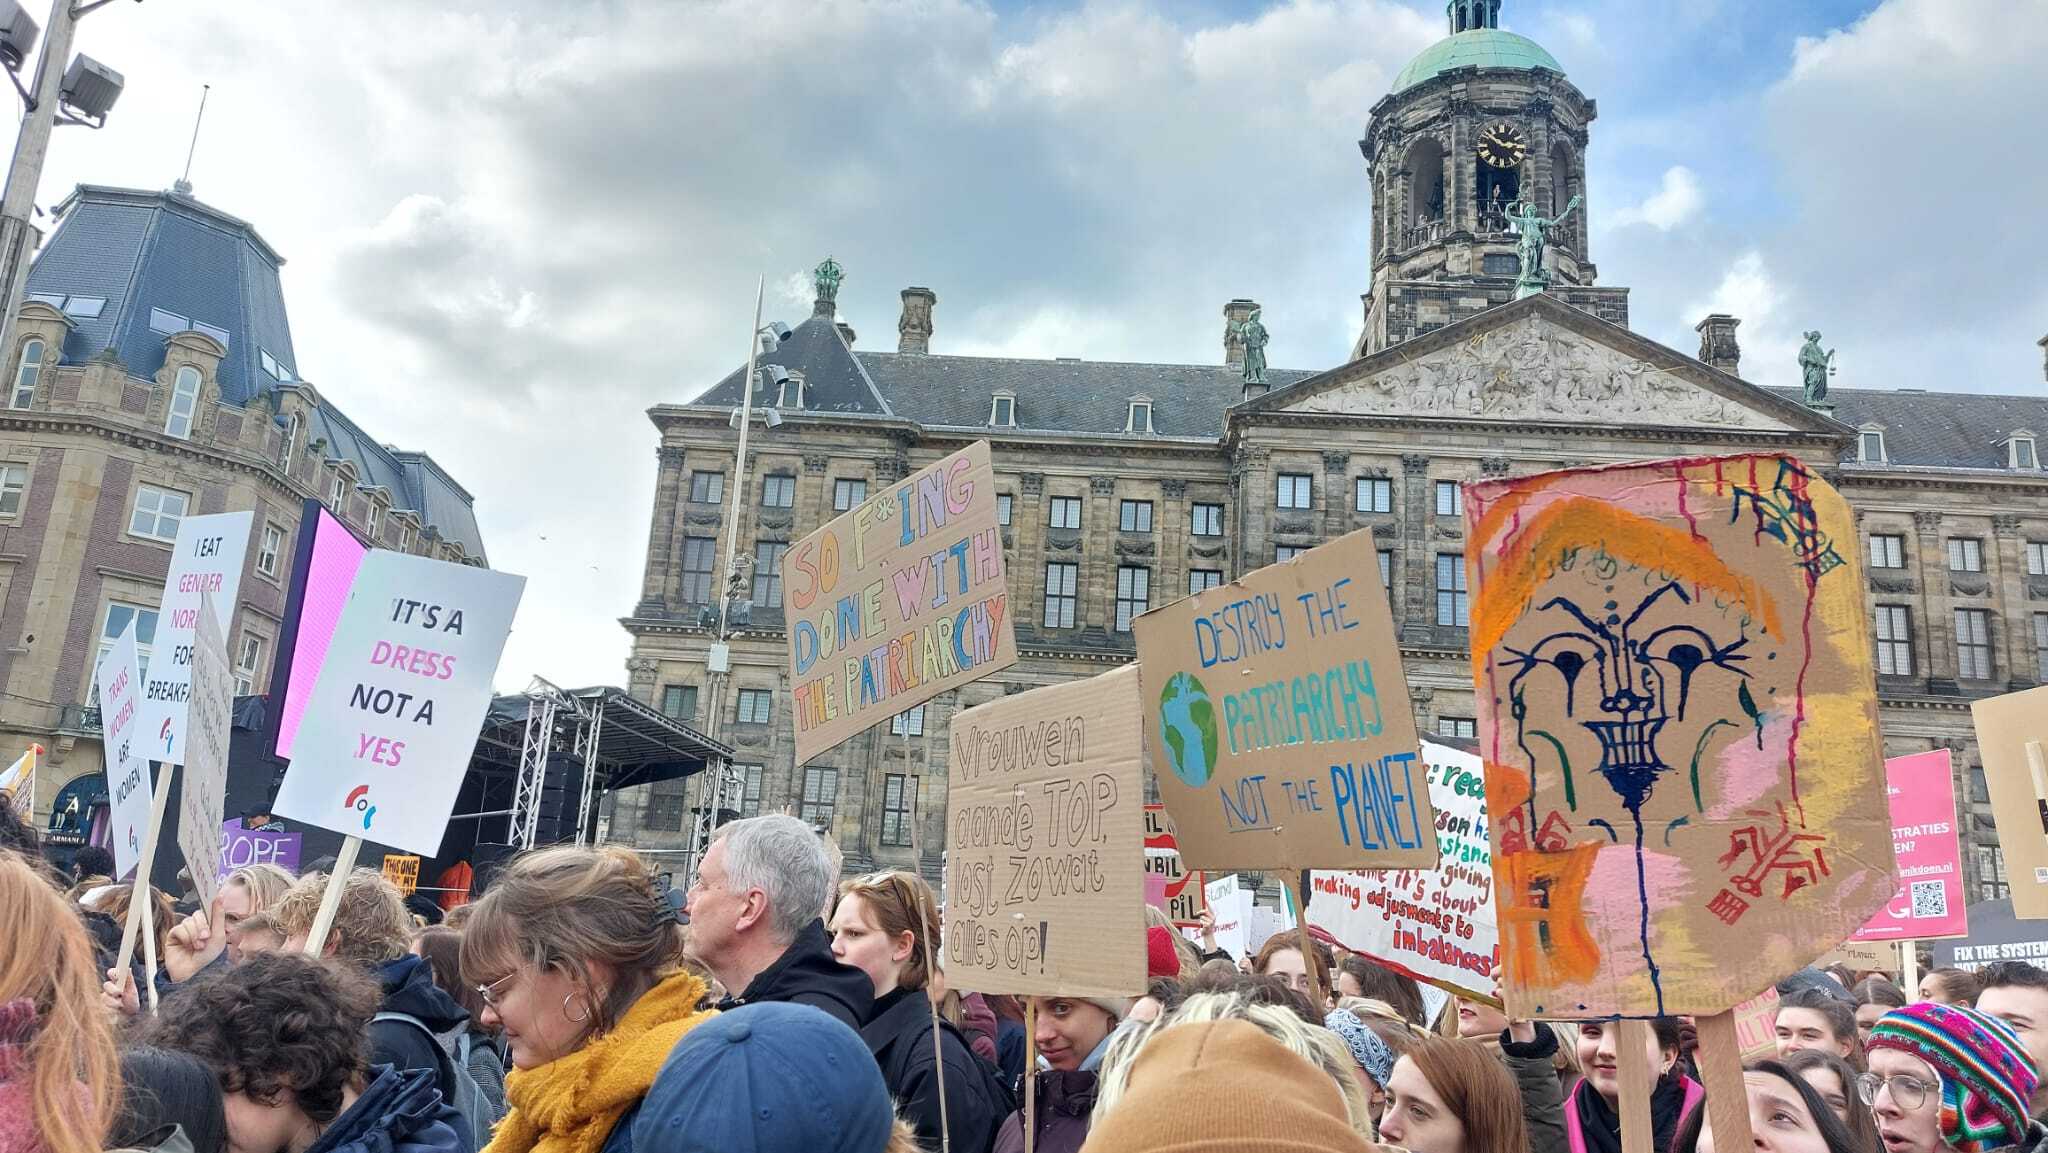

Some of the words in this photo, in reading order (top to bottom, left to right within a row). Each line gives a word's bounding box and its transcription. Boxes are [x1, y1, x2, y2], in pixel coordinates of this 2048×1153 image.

[200, 536, 223, 557] EAT
[792, 530, 840, 610] SO
[391, 598, 442, 629] IT'S
[443, 609, 464, 636] A
[794, 579, 887, 676] DONE
[892, 527, 1000, 622] WITH
[1194, 592, 1286, 669] DESTROY
[1297, 577, 1360, 638] THE
[370, 640, 457, 680] DRESS
[793, 672, 838, 732] THE
[843, 593, 1006, 717] PATRIARCHY
[108, 665, 129, 702] TRANS
[349, 683, 413, 719] NOT
[412, 699, 434, 726] A
[109, 696, 134, 739] WOMEN
[1222, 658, 1384, 756] PATRIARCHY
[117, 738, 130, 764] ARE
[355, 732, 406, 767] YES
[955, 715, 1085, 781] Vrouwen
[115, 764, 142, 807] WOMEN
[1219, 775, 1270, 829] NOT
[1281, 779, 1323, 815] THE
[1329, 752, 1423, 850] PLANET
[954, 783, 1034, 851] aande
[400, 859, 419, 876] ONE
[953, 855, 999, 918] lost
[1440, 861, 1492, 906] giving
[1314, 875, 1361, 910] making
[1366, 886, 1454, 934] adjusments
[1455, 914, 1474, 940] to
[1431, 890, 1478, 917] about
[950, 919, 1000, 970] alles
[1004, 920, 1048, 976] op!
[1953, 946, 1974, 961] FIX
[1975, 944, 2000, 960] THE
